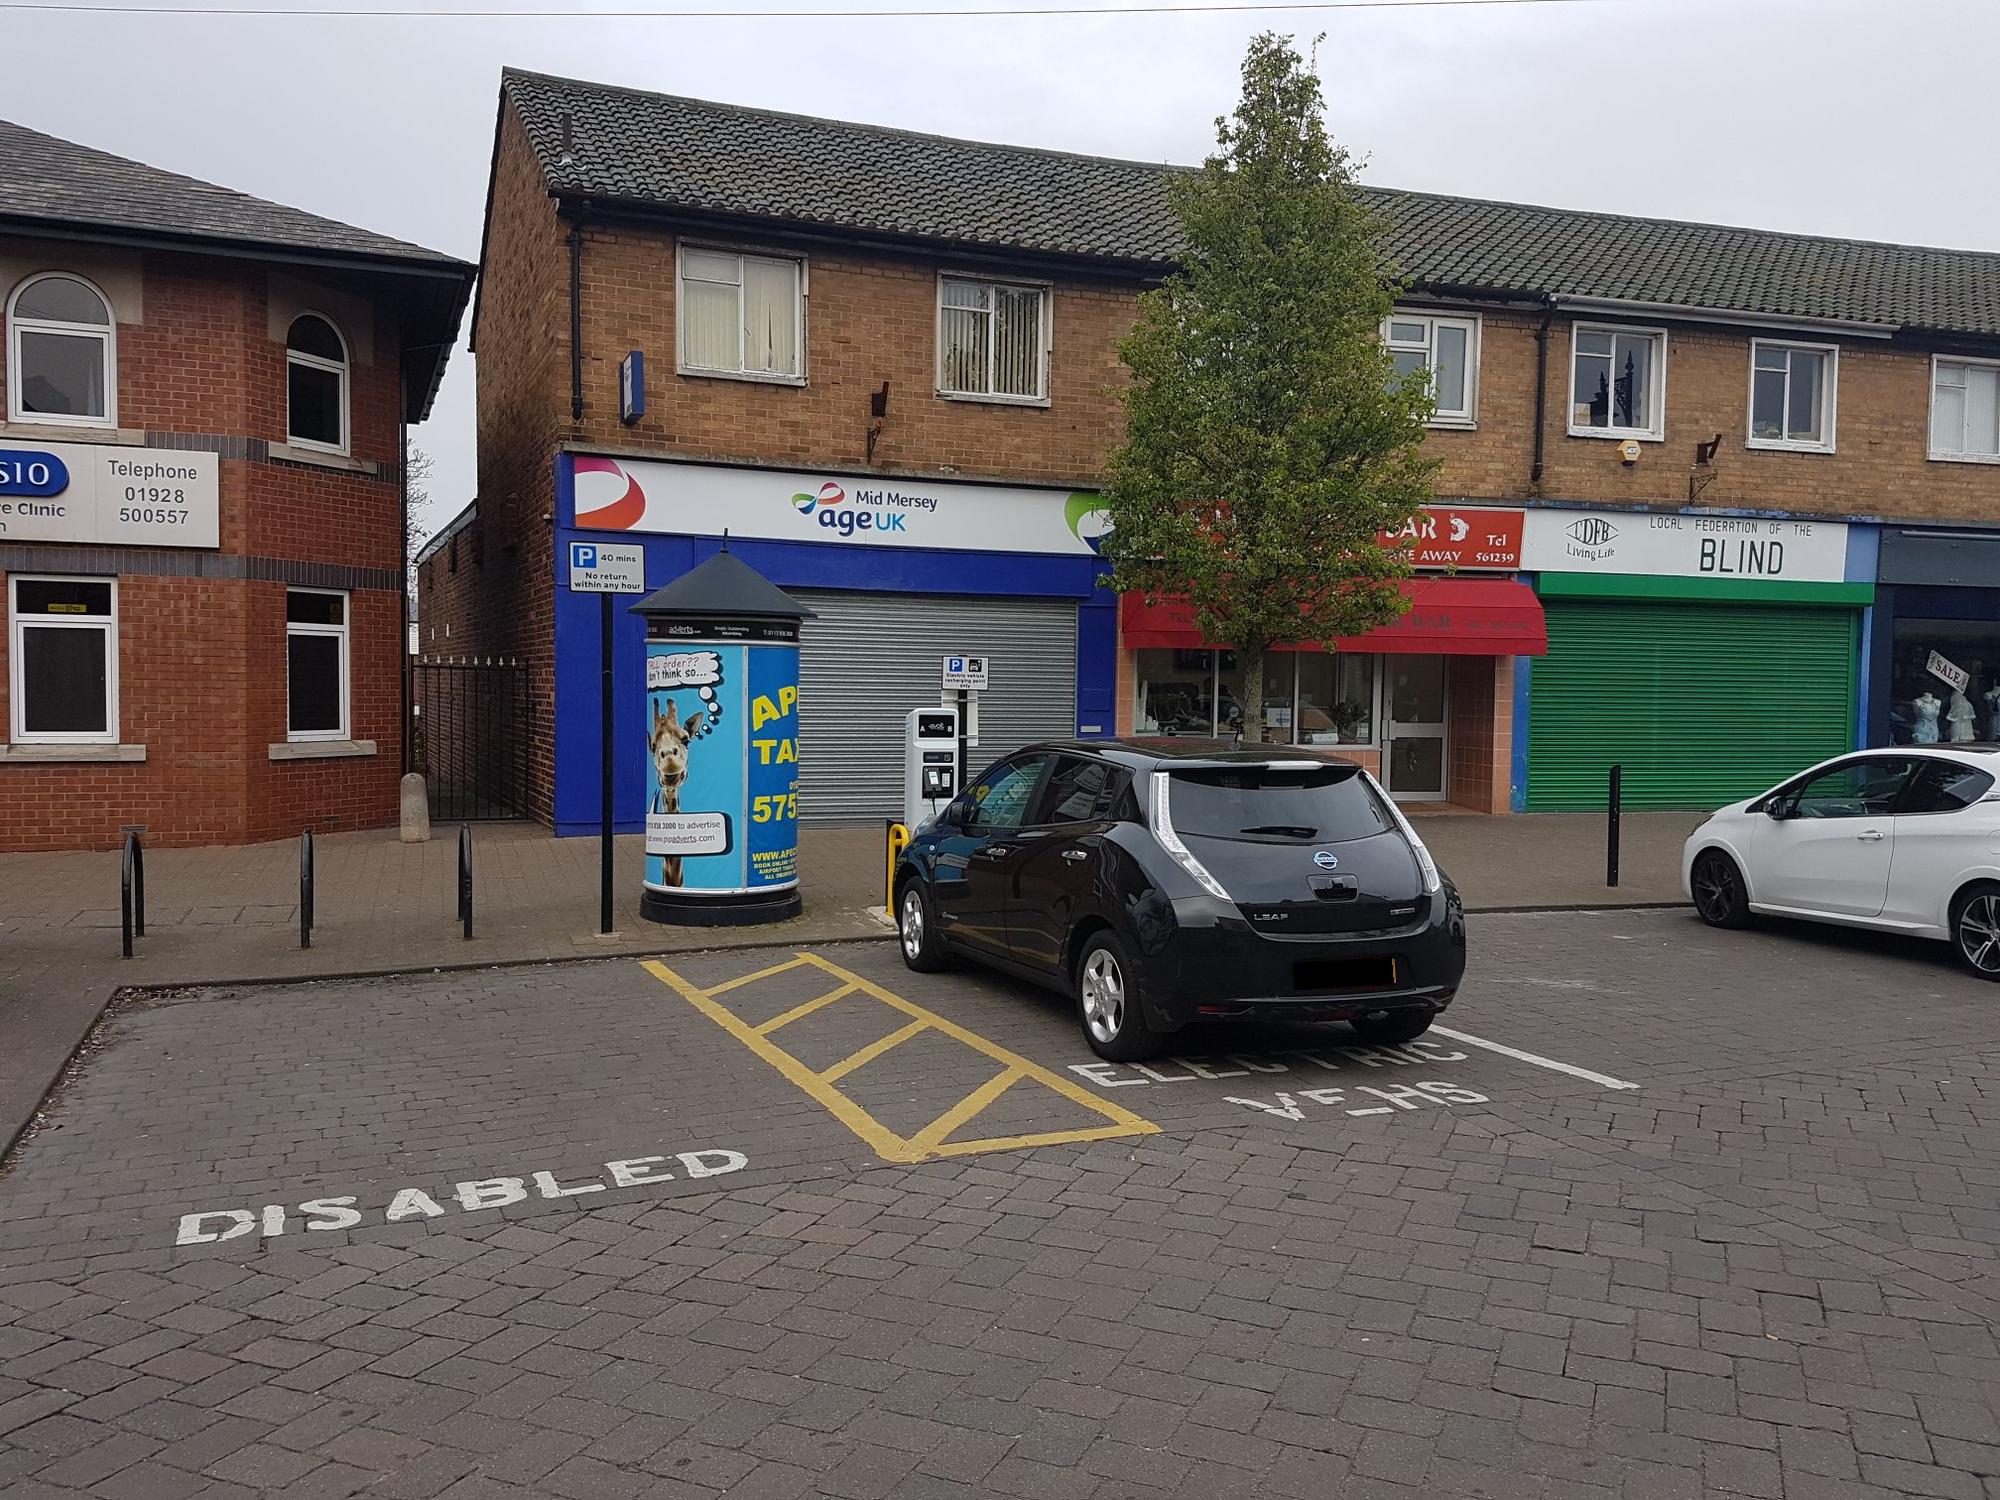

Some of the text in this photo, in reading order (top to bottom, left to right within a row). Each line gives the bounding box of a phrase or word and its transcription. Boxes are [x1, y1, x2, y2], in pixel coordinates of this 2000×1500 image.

[108, 460, 198, 481] Telephone
[125, 487, 184, 503] 01928
[856, 490, 938, 512] Mid Mersey
[18, 503, 65, 517] Clinic
[119, 508, 189, 525] 500557
[818, 508, 906, 537] age UK
[1650, 517, 1812, 537] LOCAL FEDERATION OF THE
[1486, 534, 1506, 547] Tel
[578, 548, 637, 566] P 40 mins
[1420, 550, 1462, 562] AWAY
[1475, 552, 1514, 563] 561239
[1566, 545, 1615, 561] Living Life
[1700, 538, 1784, 575] BLIND
[585, 572, 628, 581] No return
[574, 581, 641, 590] within any hour
[662, 668, 682, 679] think
[1934, 659, 1961, 684] SALE
[752, 685, 799, 732] AP
[752, 794, 798, 823] 575
[686, 820, 721, 830] advertise
[1067, 1041, 1469, 1087] ELECTRIC
[176, 1149, 749, 1245] DISABLED
